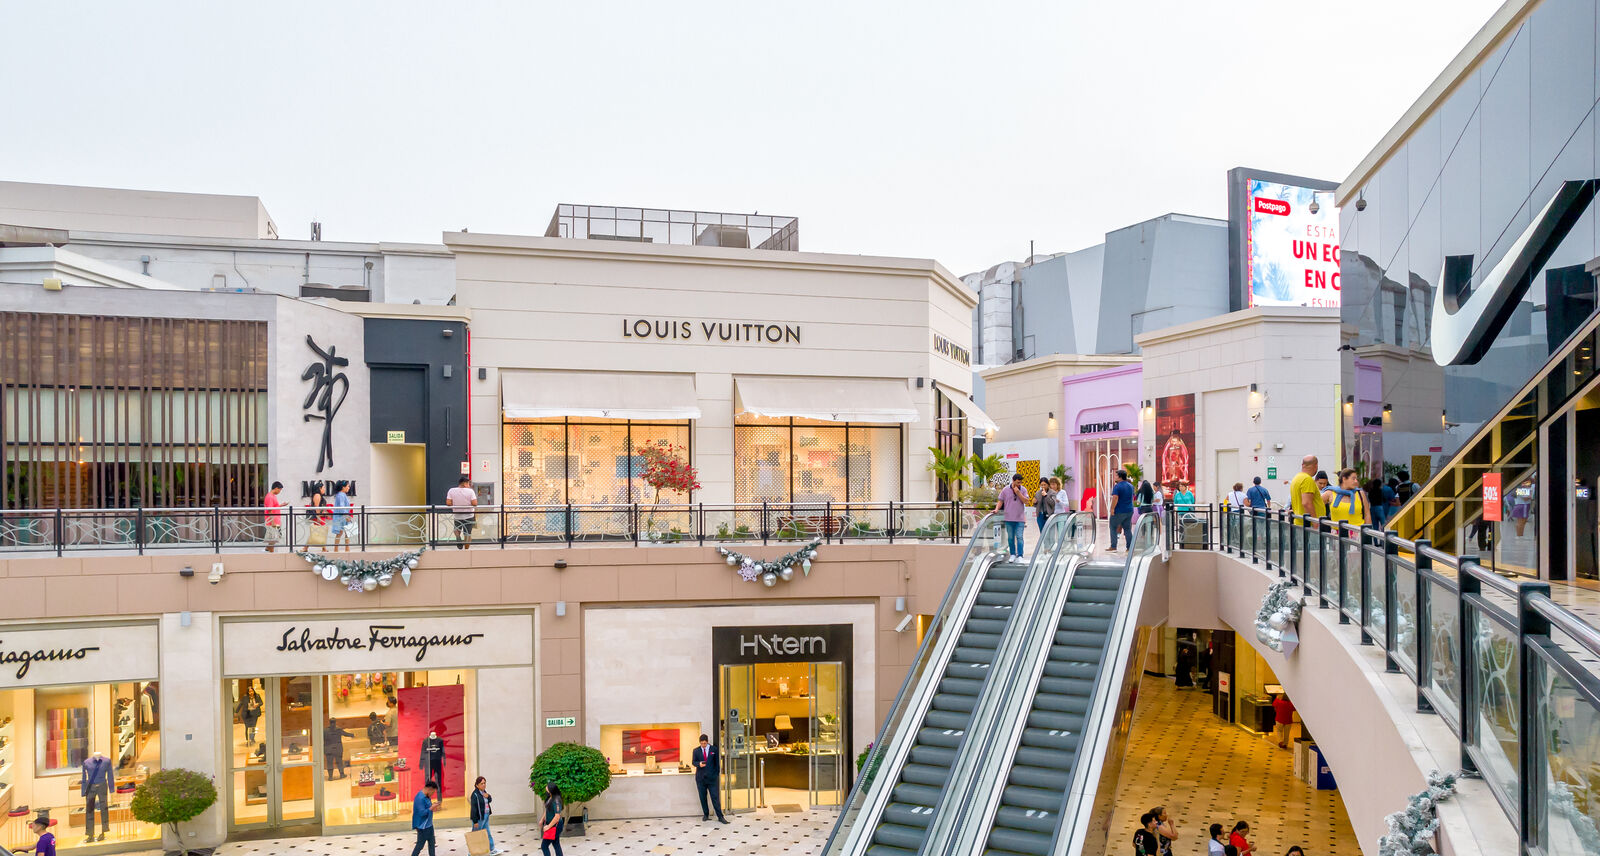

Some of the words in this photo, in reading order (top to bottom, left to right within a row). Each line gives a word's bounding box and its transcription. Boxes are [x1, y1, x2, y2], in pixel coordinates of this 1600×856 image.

[1258, 200, 1286, 213] Postpago
[1306, 224, 1335, 239] ESTA
[1292, 239, 1317, 261] UN
[1304, 268, 1326, 289] EN
[623, 319, 692, 339] LOUIS
[702, 322, 801, 344] VUITTON
[933, 333, 949, 356] LOUIS
[950, 342, 970, 367] VUITTON
[276, 627, 366, 652] Salvatore
[369, 625, 484, 662] Ferragamo
